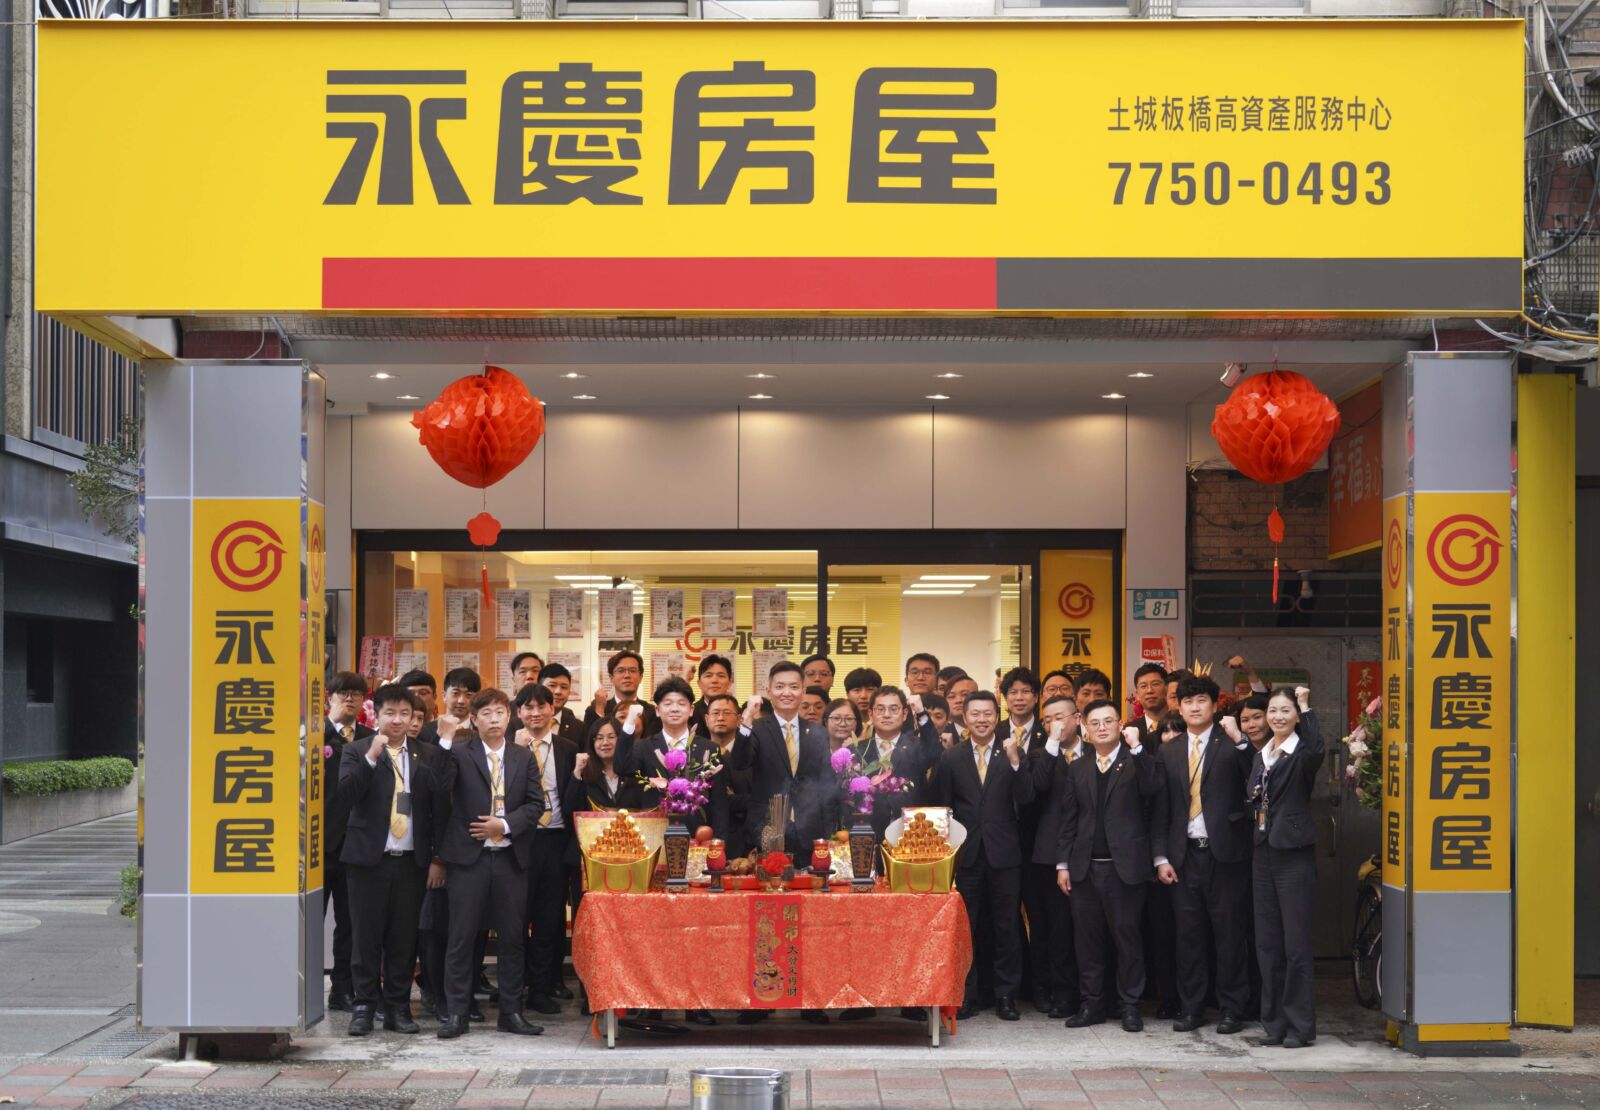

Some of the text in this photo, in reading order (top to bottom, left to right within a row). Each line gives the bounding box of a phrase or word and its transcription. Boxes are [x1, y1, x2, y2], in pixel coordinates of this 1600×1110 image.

[322, 60, 998, 206] 永慶房屋
[1107, 95, 1392, 133] 土城板橋高資產服務中心
[1108, 161, 1392, 206] 7750-0493
[1152, 600, 1171, 617] 81
[213, 610, 276, 874] 永慶房屋
[1388, 607, 1400, 867] 永慶房屋
[1430, 603, 1493, 871] 永慶房屋
